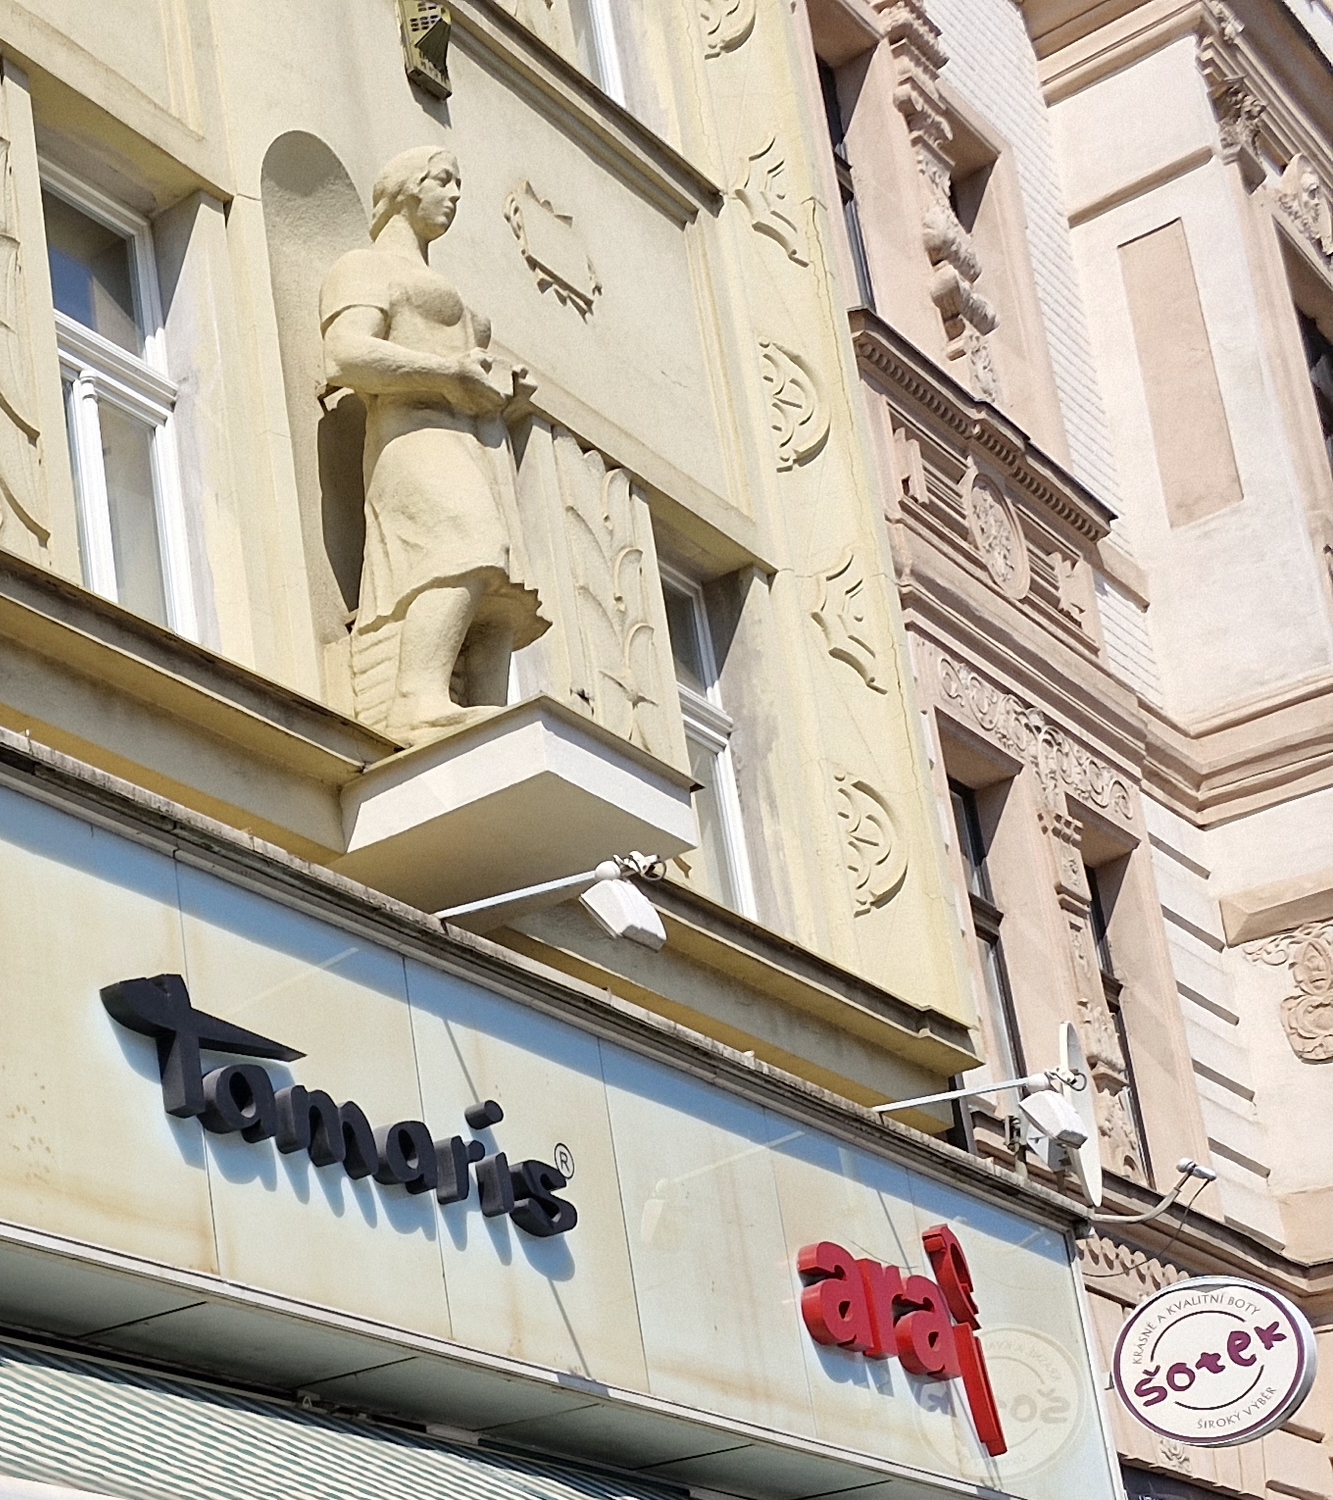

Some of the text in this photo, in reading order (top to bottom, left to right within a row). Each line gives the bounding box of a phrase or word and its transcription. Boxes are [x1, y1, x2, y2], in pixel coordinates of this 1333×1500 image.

[99, 973, 578, 1238] Tamaris
[1132, 1293, 1261, 1365] KRÁSNÉ A KVALITNÍ BOTY
[1133, 1321, 1287, 1407] Šotek
[1197, 1386, 1277, 1430] ŠIROKÝ VÝBĚR
